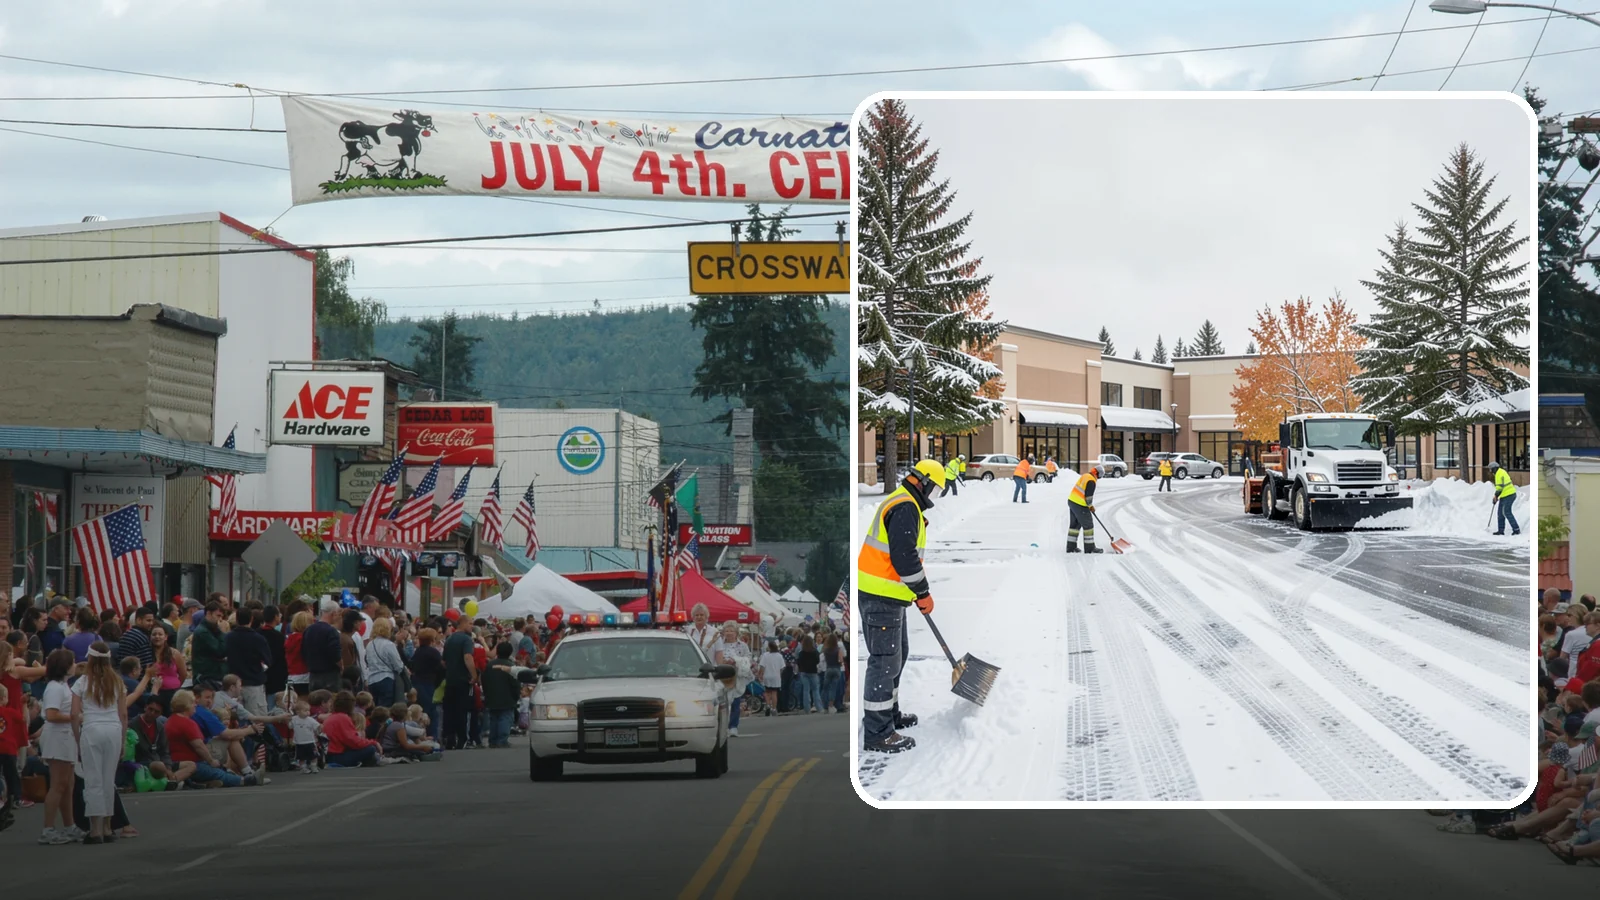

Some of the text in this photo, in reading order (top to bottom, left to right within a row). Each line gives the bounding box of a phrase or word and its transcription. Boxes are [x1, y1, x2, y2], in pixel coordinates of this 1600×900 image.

[481, 140, 605, 192] JULY
[632, 150, 746, 198] 4th.
[282, 380, 373, 420] ACE
[405, 409, 485, 422] CEDAR LOG
[283, 421, 371, 437] Hardware
[96, 485, 124, 495] Vincent
[126, 485, 136, 495] de
[137, 486, 155, 495] Paul
[688, 526, 741, 535] CRNATION
[699, 535, 730, 543] GLASS
